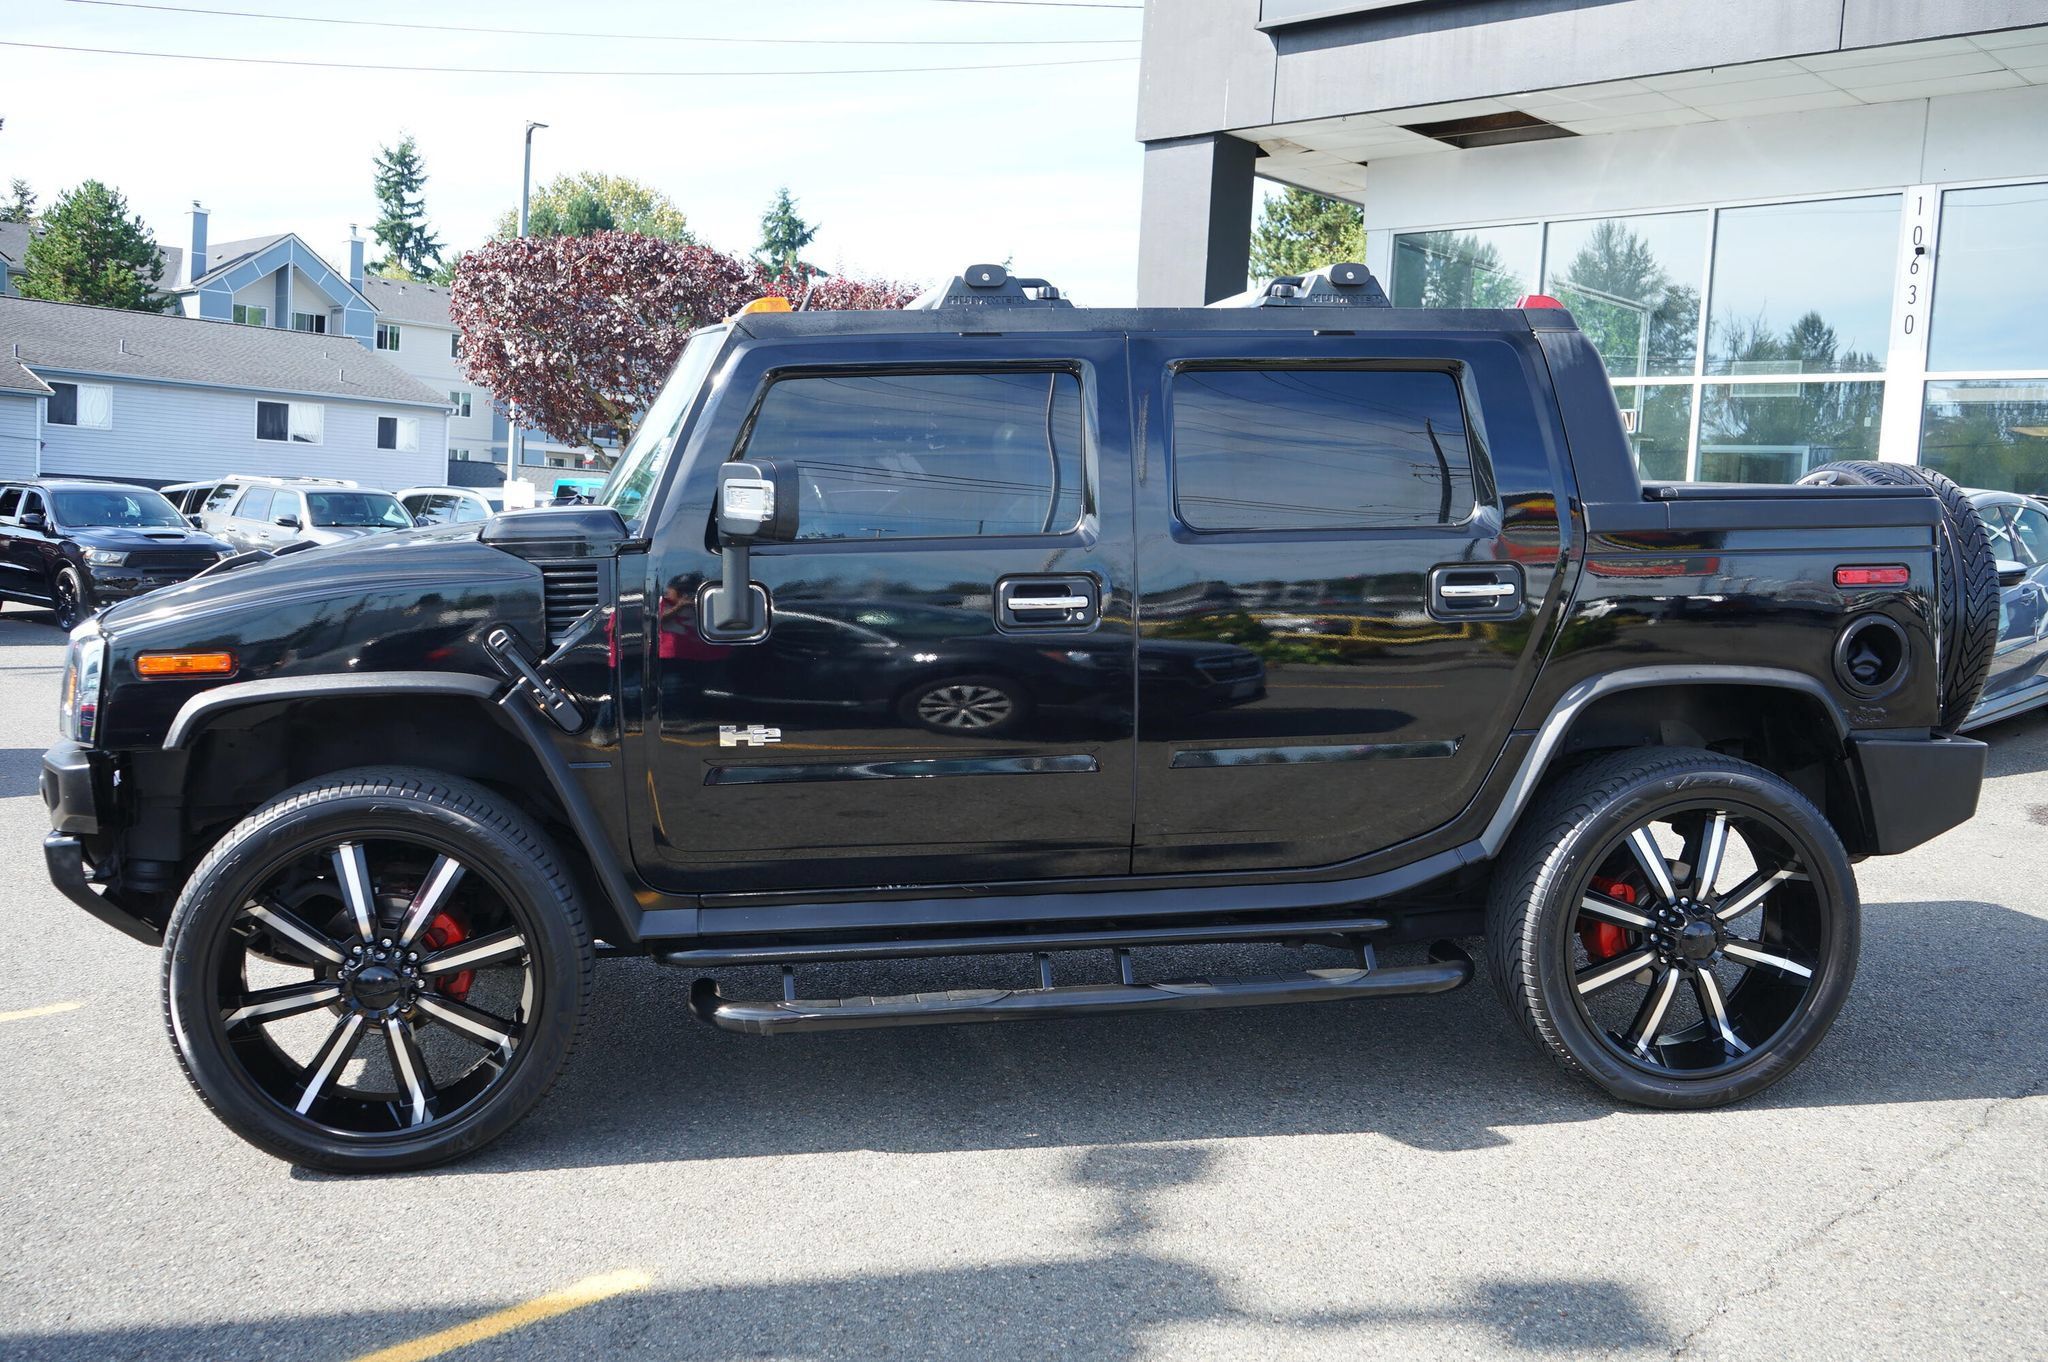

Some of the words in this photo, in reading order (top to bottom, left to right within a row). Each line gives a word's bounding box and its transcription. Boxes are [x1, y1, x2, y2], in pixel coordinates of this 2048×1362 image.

[1904, 196, 1923, 335] 10630
[947, 295, 1025, 305] HUMMER
[719, 724, 782, 747] H2
